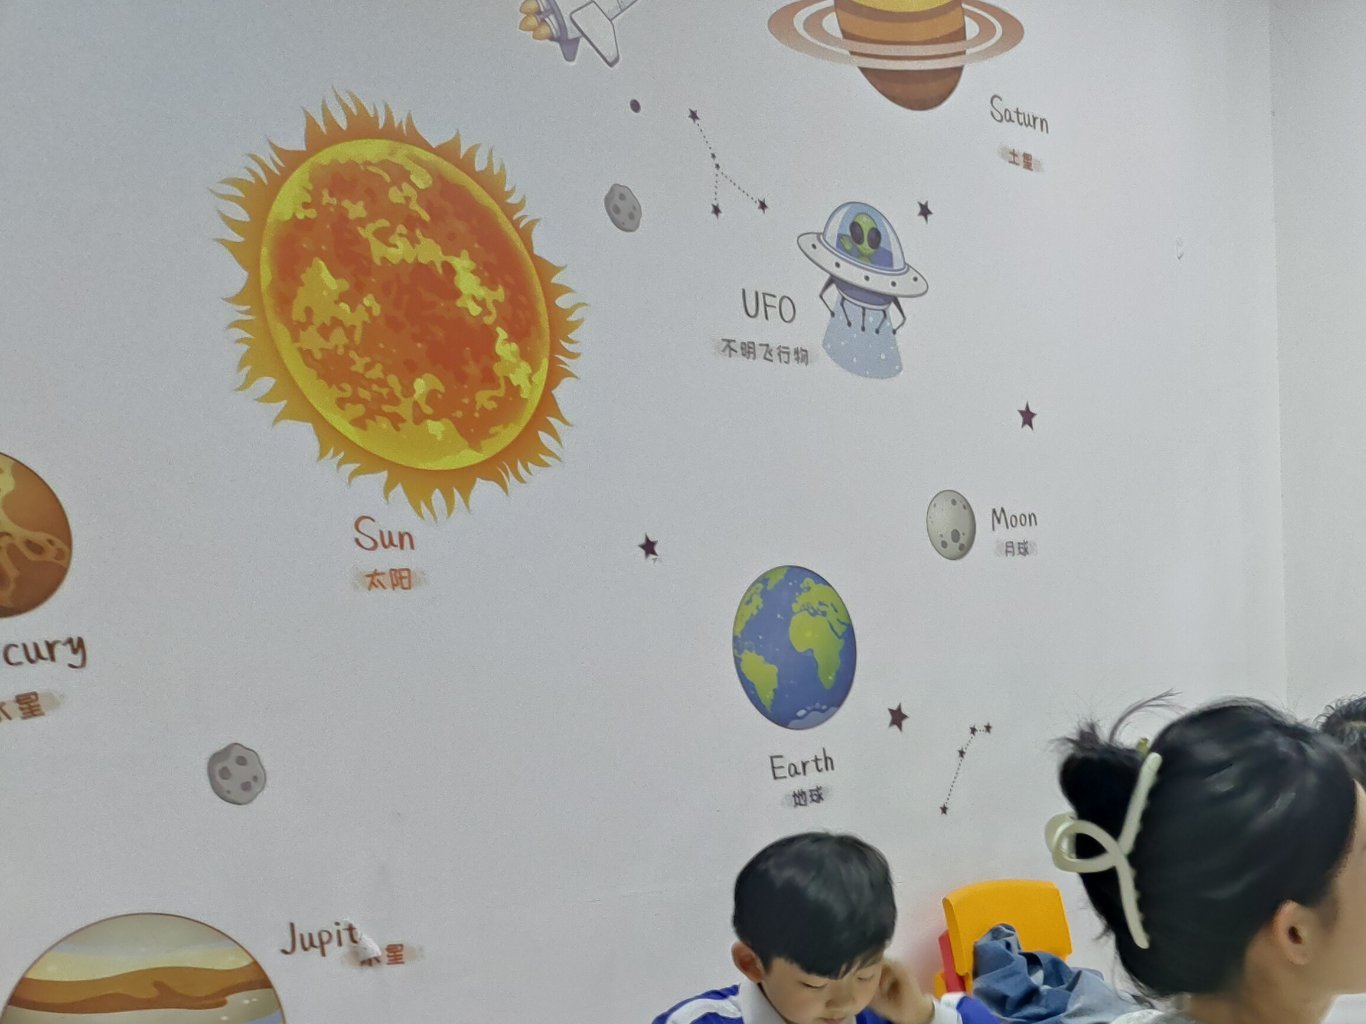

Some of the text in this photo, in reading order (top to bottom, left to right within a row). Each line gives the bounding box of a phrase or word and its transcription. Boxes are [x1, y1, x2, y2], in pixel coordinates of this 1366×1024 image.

[989, 94, 1048, 134] Saturn
[1007, 148, 1034, 172] 土星
[742, 288, 796, 323] UFO
[720, 338, 809, 366] 不明飞行物
[354, 515, 415, 551] Sun
[991, 506, 1038, 531] Moon
[1005, 540, 1029, 557] 月球
[364, 568, 412, 591] 太阳
[3, 636, 87, 669] cury
[769, 747, 835, 780] Earth
[792, 785, 824, 808] 地球
[279, 921, 359, 957] Jupit
